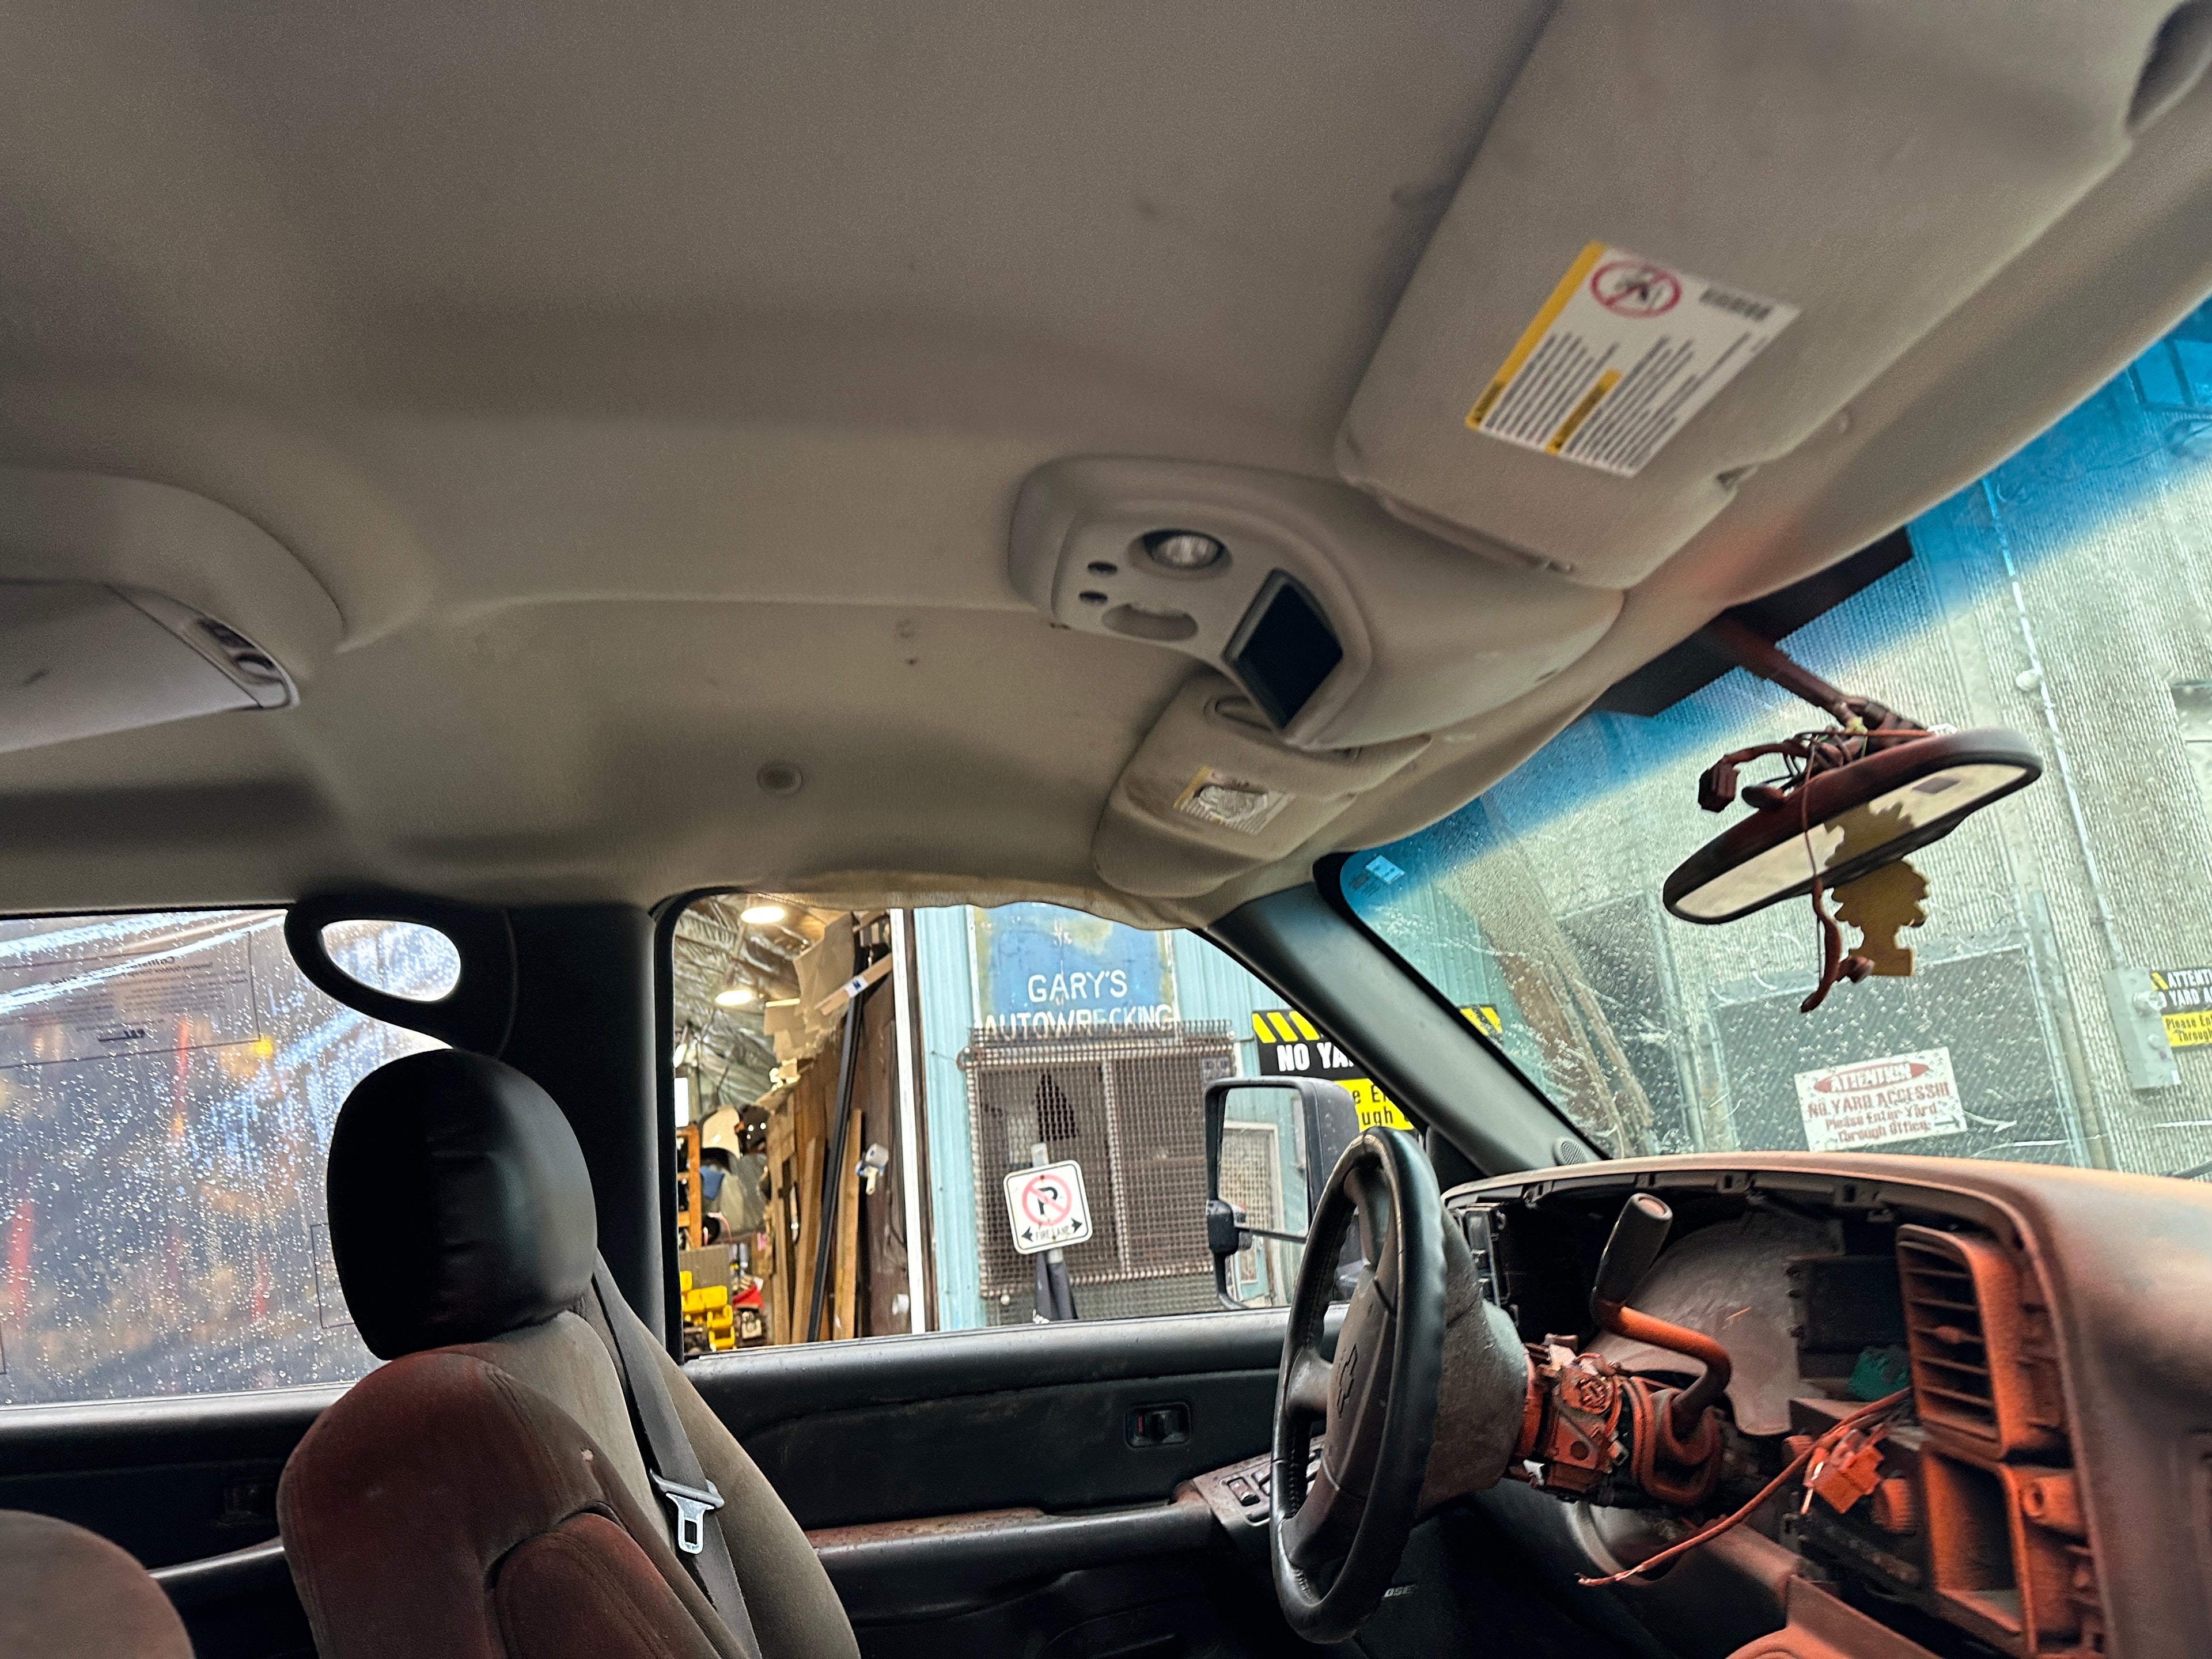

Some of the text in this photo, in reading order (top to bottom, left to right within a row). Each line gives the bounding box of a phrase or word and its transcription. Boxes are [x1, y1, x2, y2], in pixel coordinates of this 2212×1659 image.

[1028, 969, 1127, 1003] GARY'S
[2169, 988, 2200, 1007] YARD
[1277, 1043, 1310, 1072] NO
[1807, 1102, 1827, 1118] NO
[1831, 1094, 1872, 1114] YARD
